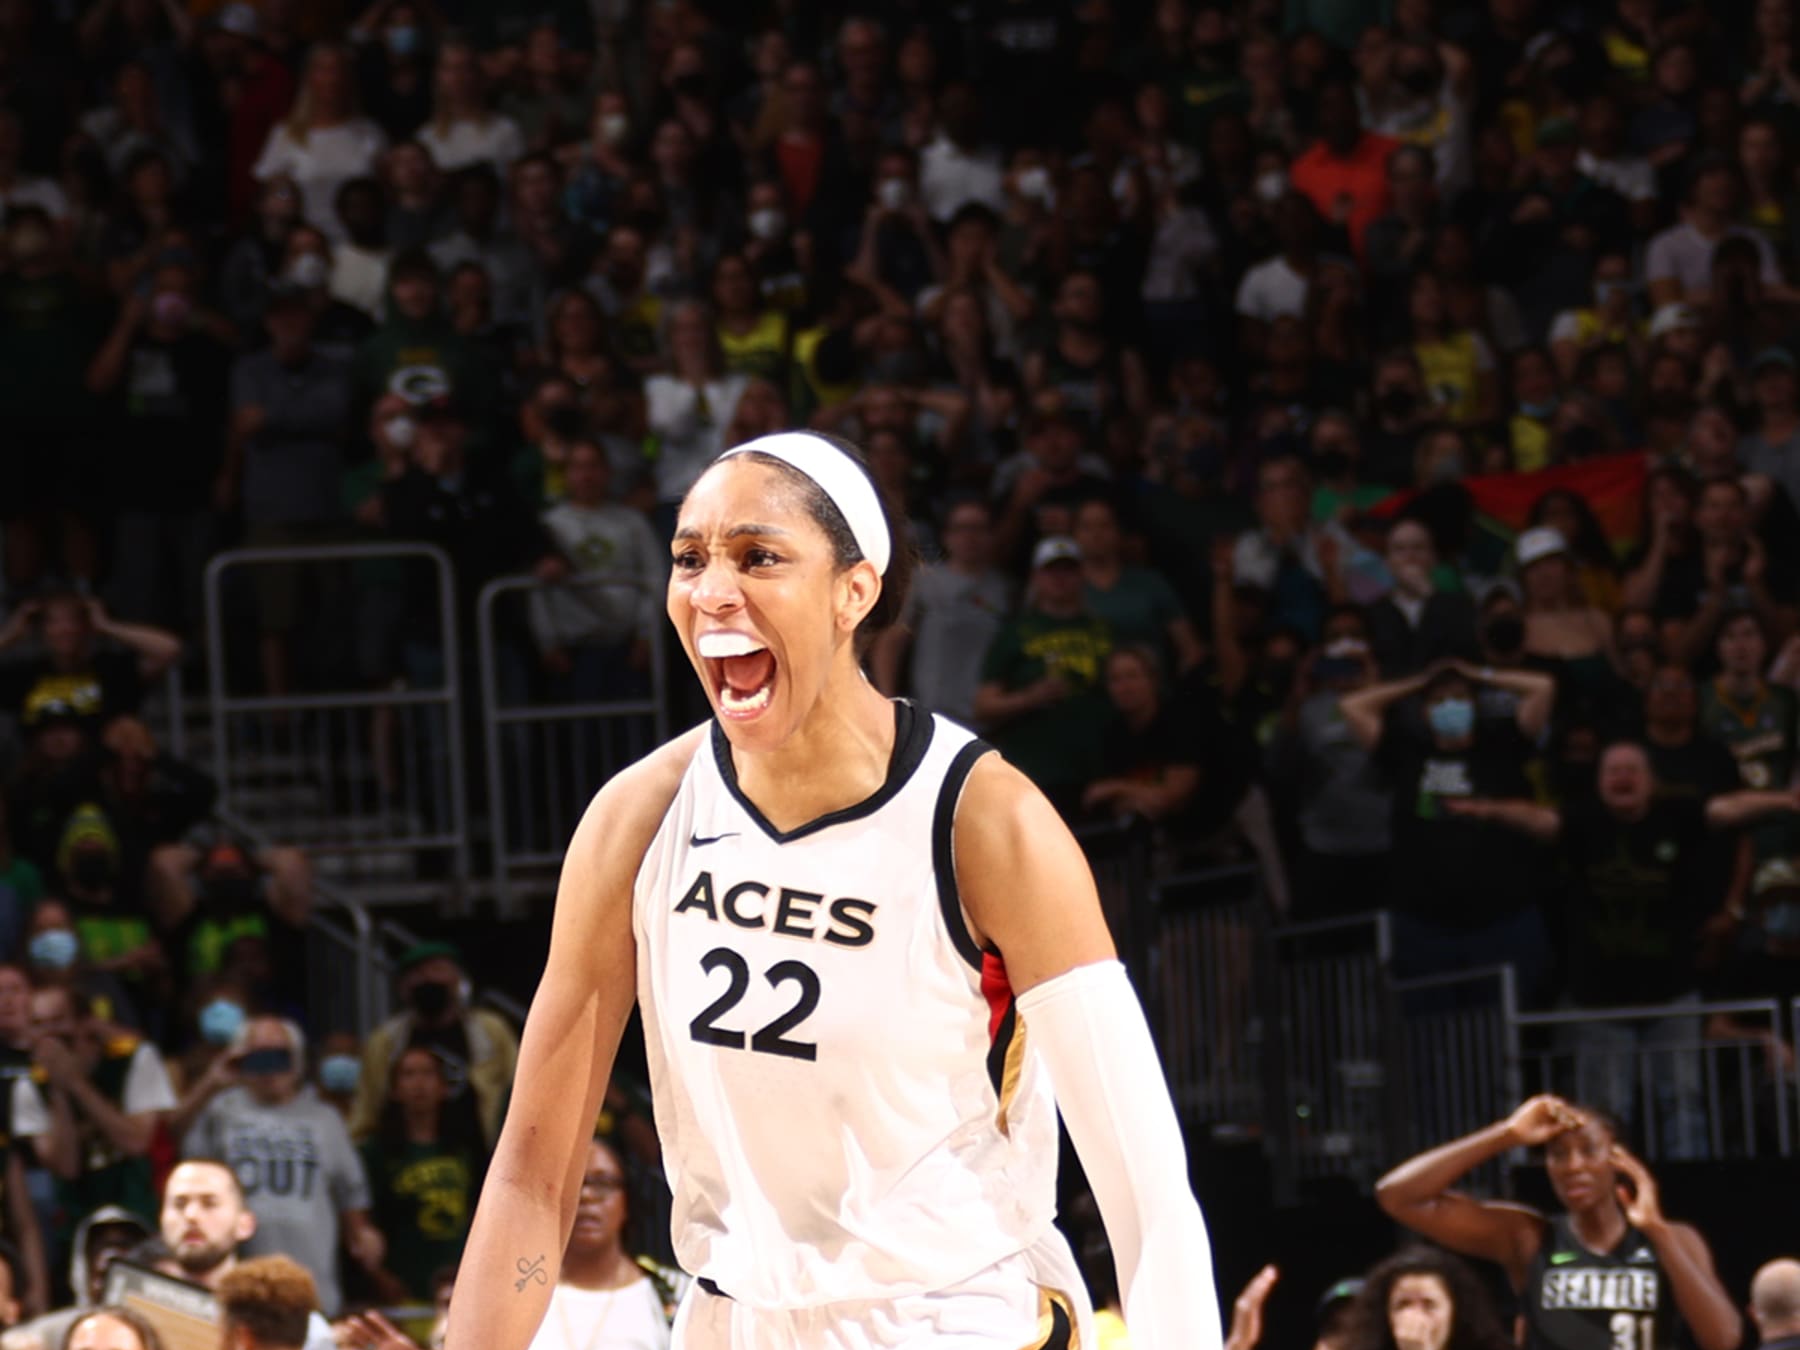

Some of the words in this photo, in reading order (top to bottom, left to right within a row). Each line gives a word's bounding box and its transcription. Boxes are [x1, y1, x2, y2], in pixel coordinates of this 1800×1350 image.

[674, 870, 878, 948] ACES
[689, 946, 822, 1063] 22
[1541, 1267, 1659, 1310] SEATTLE
